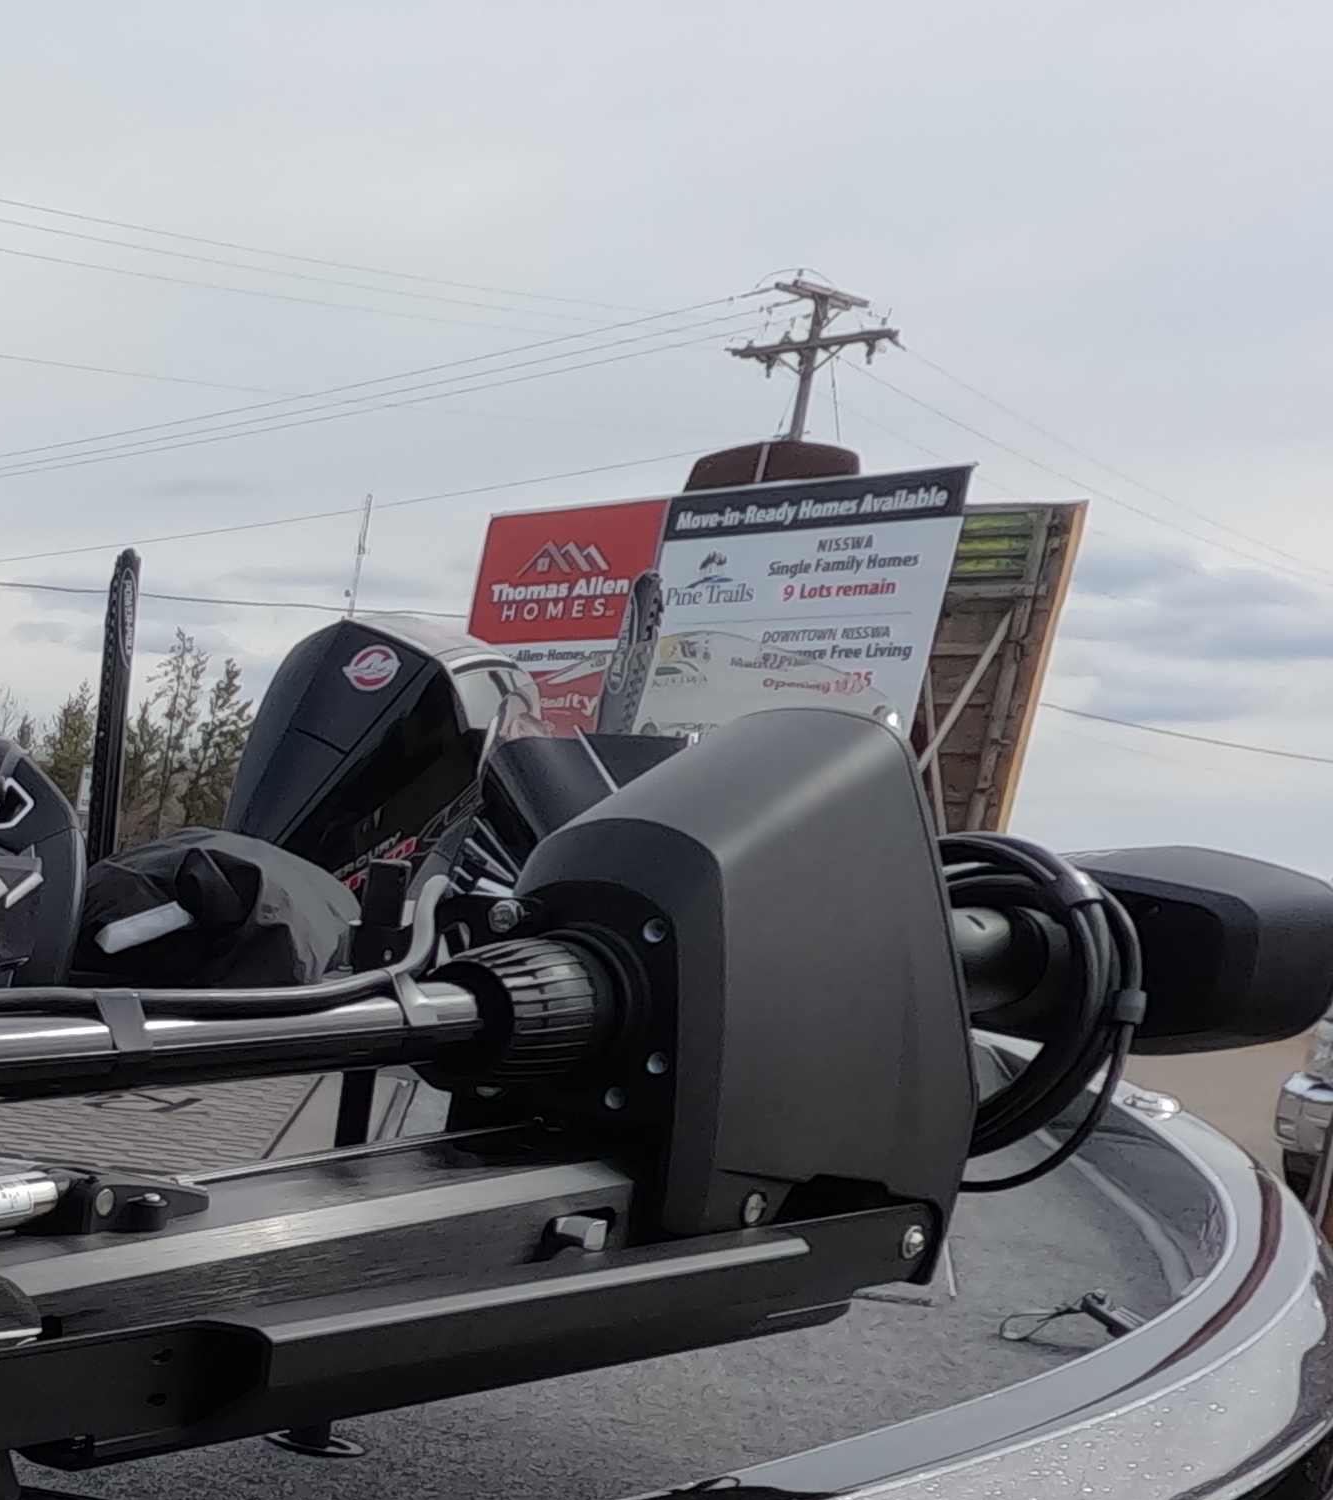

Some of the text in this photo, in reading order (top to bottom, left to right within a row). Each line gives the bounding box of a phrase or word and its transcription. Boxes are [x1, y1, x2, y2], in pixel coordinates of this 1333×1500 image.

[676, 485, 949, 531] Move-in-Ready Homes Available
[817, 534, 874, 553] NISSWA
[768, 552, 920, 580] Single Family Homes
[491, 576, 630, 602] Thomas Allen
[666, 582, 754, 607] Pine Trails
[783, 578, 896, 602] 9 Lots remain
[501, 599, 605, 621] HOMES
[762, 625, 891, 644] DOWNTOWN NISSWA
[829, 643, 861, 660] Free
[865, 644, 914, 661] Living
[541, 692, 600, 717] ealty
[333, 830, 402, 879] ERCURY
